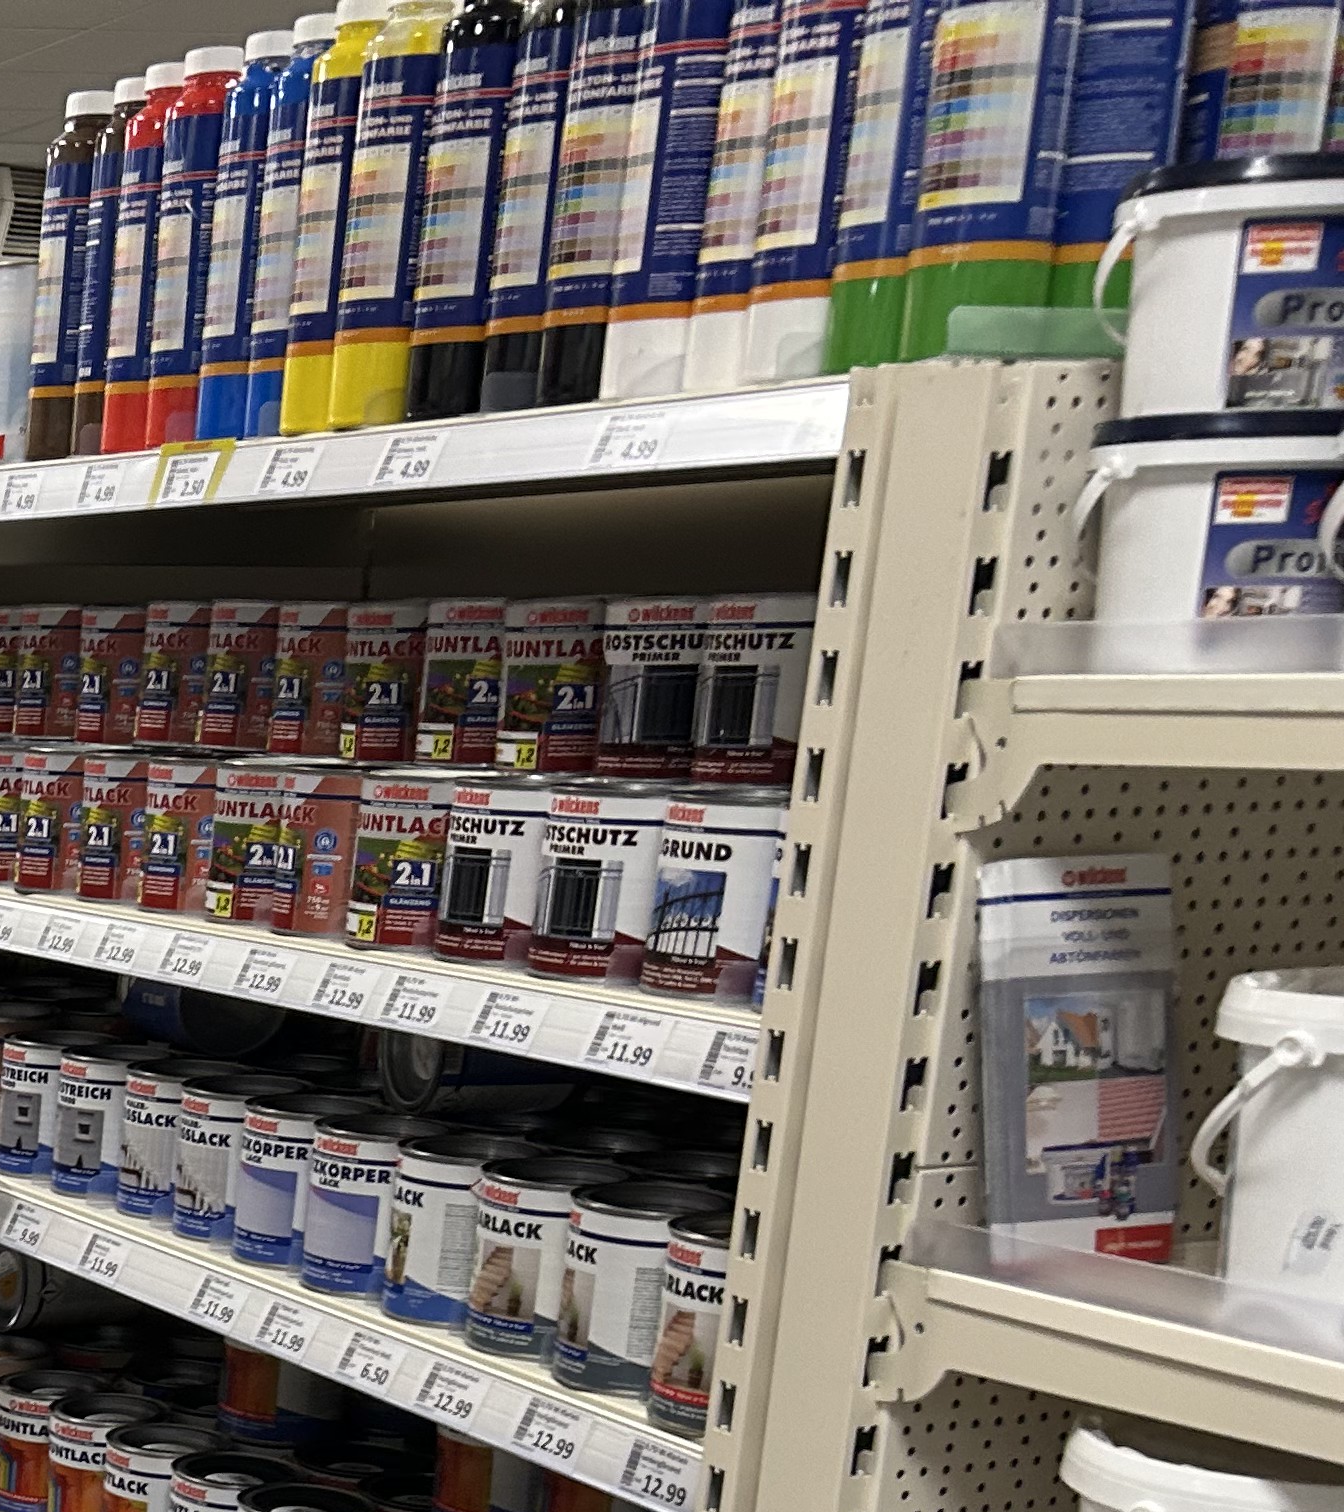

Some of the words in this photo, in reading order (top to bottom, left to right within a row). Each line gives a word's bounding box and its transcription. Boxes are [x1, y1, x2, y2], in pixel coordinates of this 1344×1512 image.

[620, 439, 658, 460] 4.99
[280, 470, 308, 487] 4.99
[399, 460, 431, 478] 4.99
[181, 480, 205, 497] 2.50
[605, 633, 703, 651] ROSTSCHU
[50, 936, 74, 953] 12.99
[107, 946, 134, 963] 12.99
[173, 957, 201, 977] 12.99
[248, 973, 281, 994] 12.99
[329, 989, 364, 1010] 12.99
[400, 1003, 437, 1024] 11.99
[490, 1019, 530, 1043] 11.99
[607, 1042, 653, 1067] 11.99
[20, 1229, 40, 1246] 9.99
[91, 1257, 118, 1278] 11.99
[206, 1301, 234, 1323] 11.99
[273, 1328, 305, 1352] 11.99
[360, 1362, 389, 1386] 6.50
[435, 1391, 473, 1419] 12.99
[533, 1429, 575, 1460] 12.99
[642, 1474, 687, 1507] 12.99
